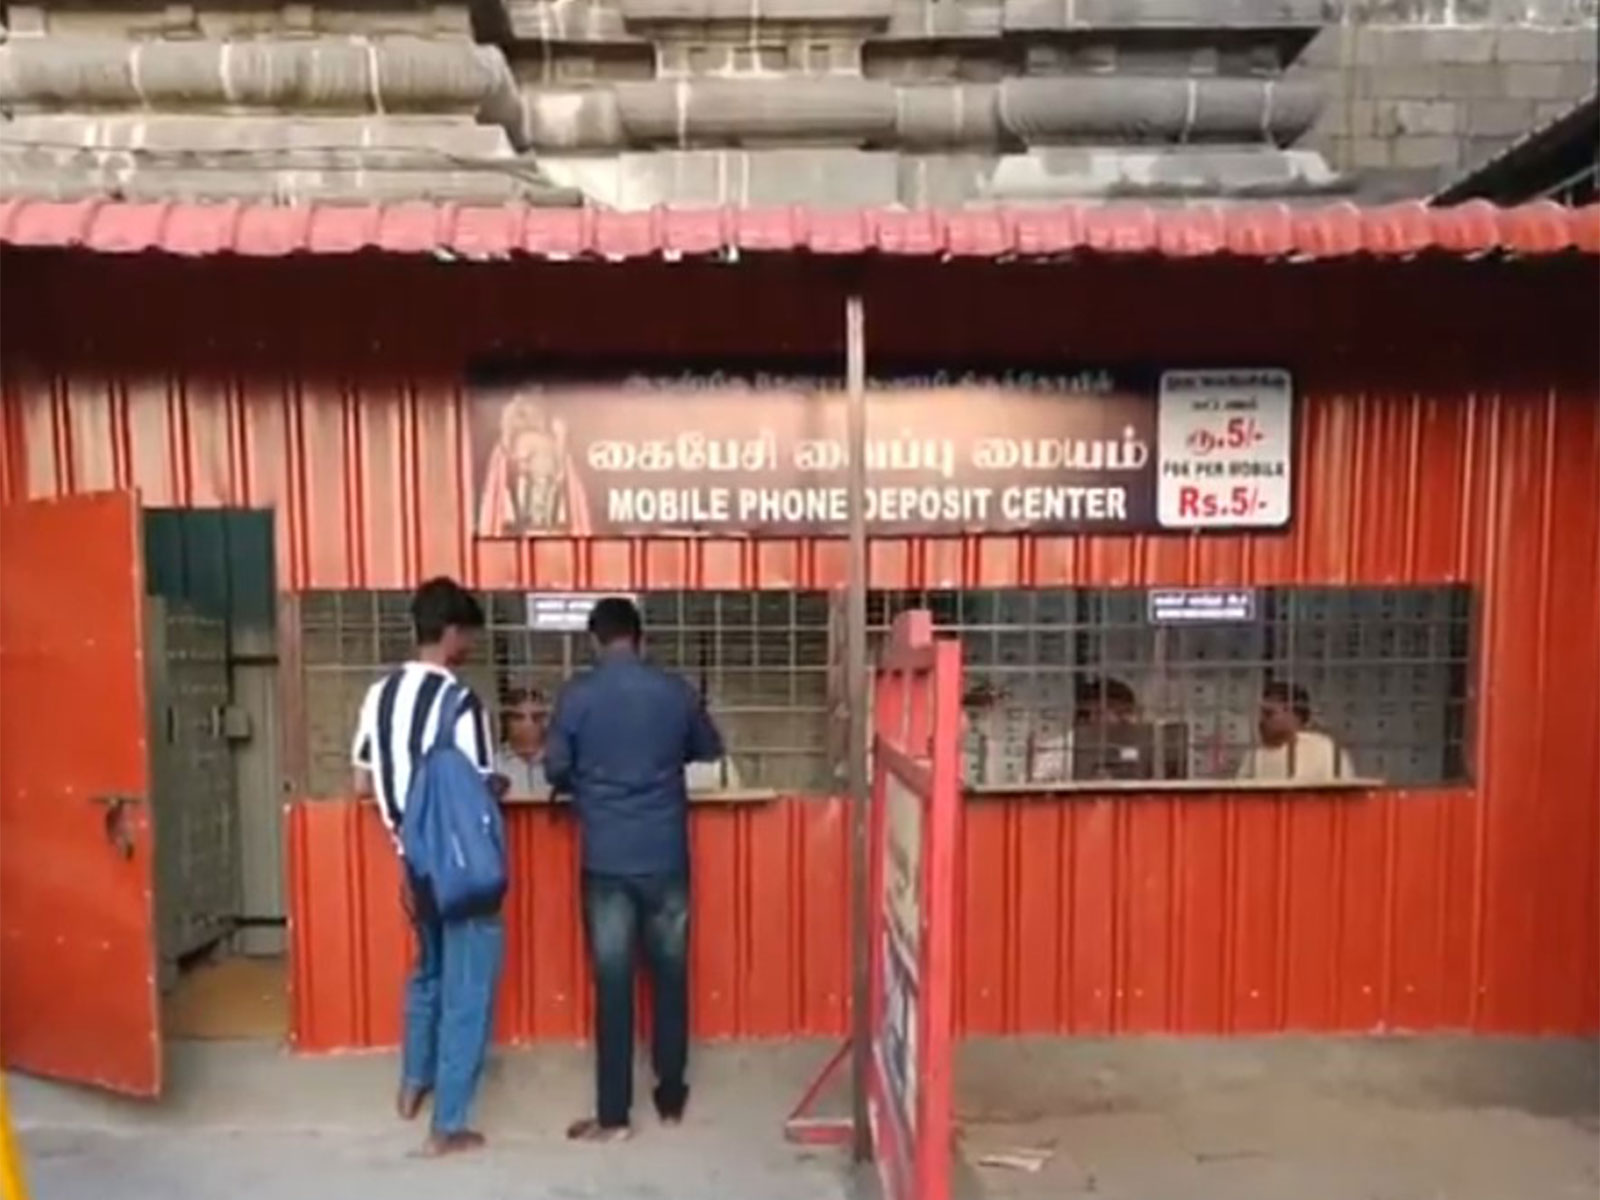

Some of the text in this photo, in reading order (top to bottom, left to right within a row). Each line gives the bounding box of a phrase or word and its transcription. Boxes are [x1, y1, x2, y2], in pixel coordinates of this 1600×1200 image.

[587, 430, 777, 471] கைபேசி
[972, 425, 1149, 470] மையம்
[608, 486, 1127, 522] MOBILE PHONE DEPOSIT CENTER
[1177, 485, 1268, 518] Rs.5/-
